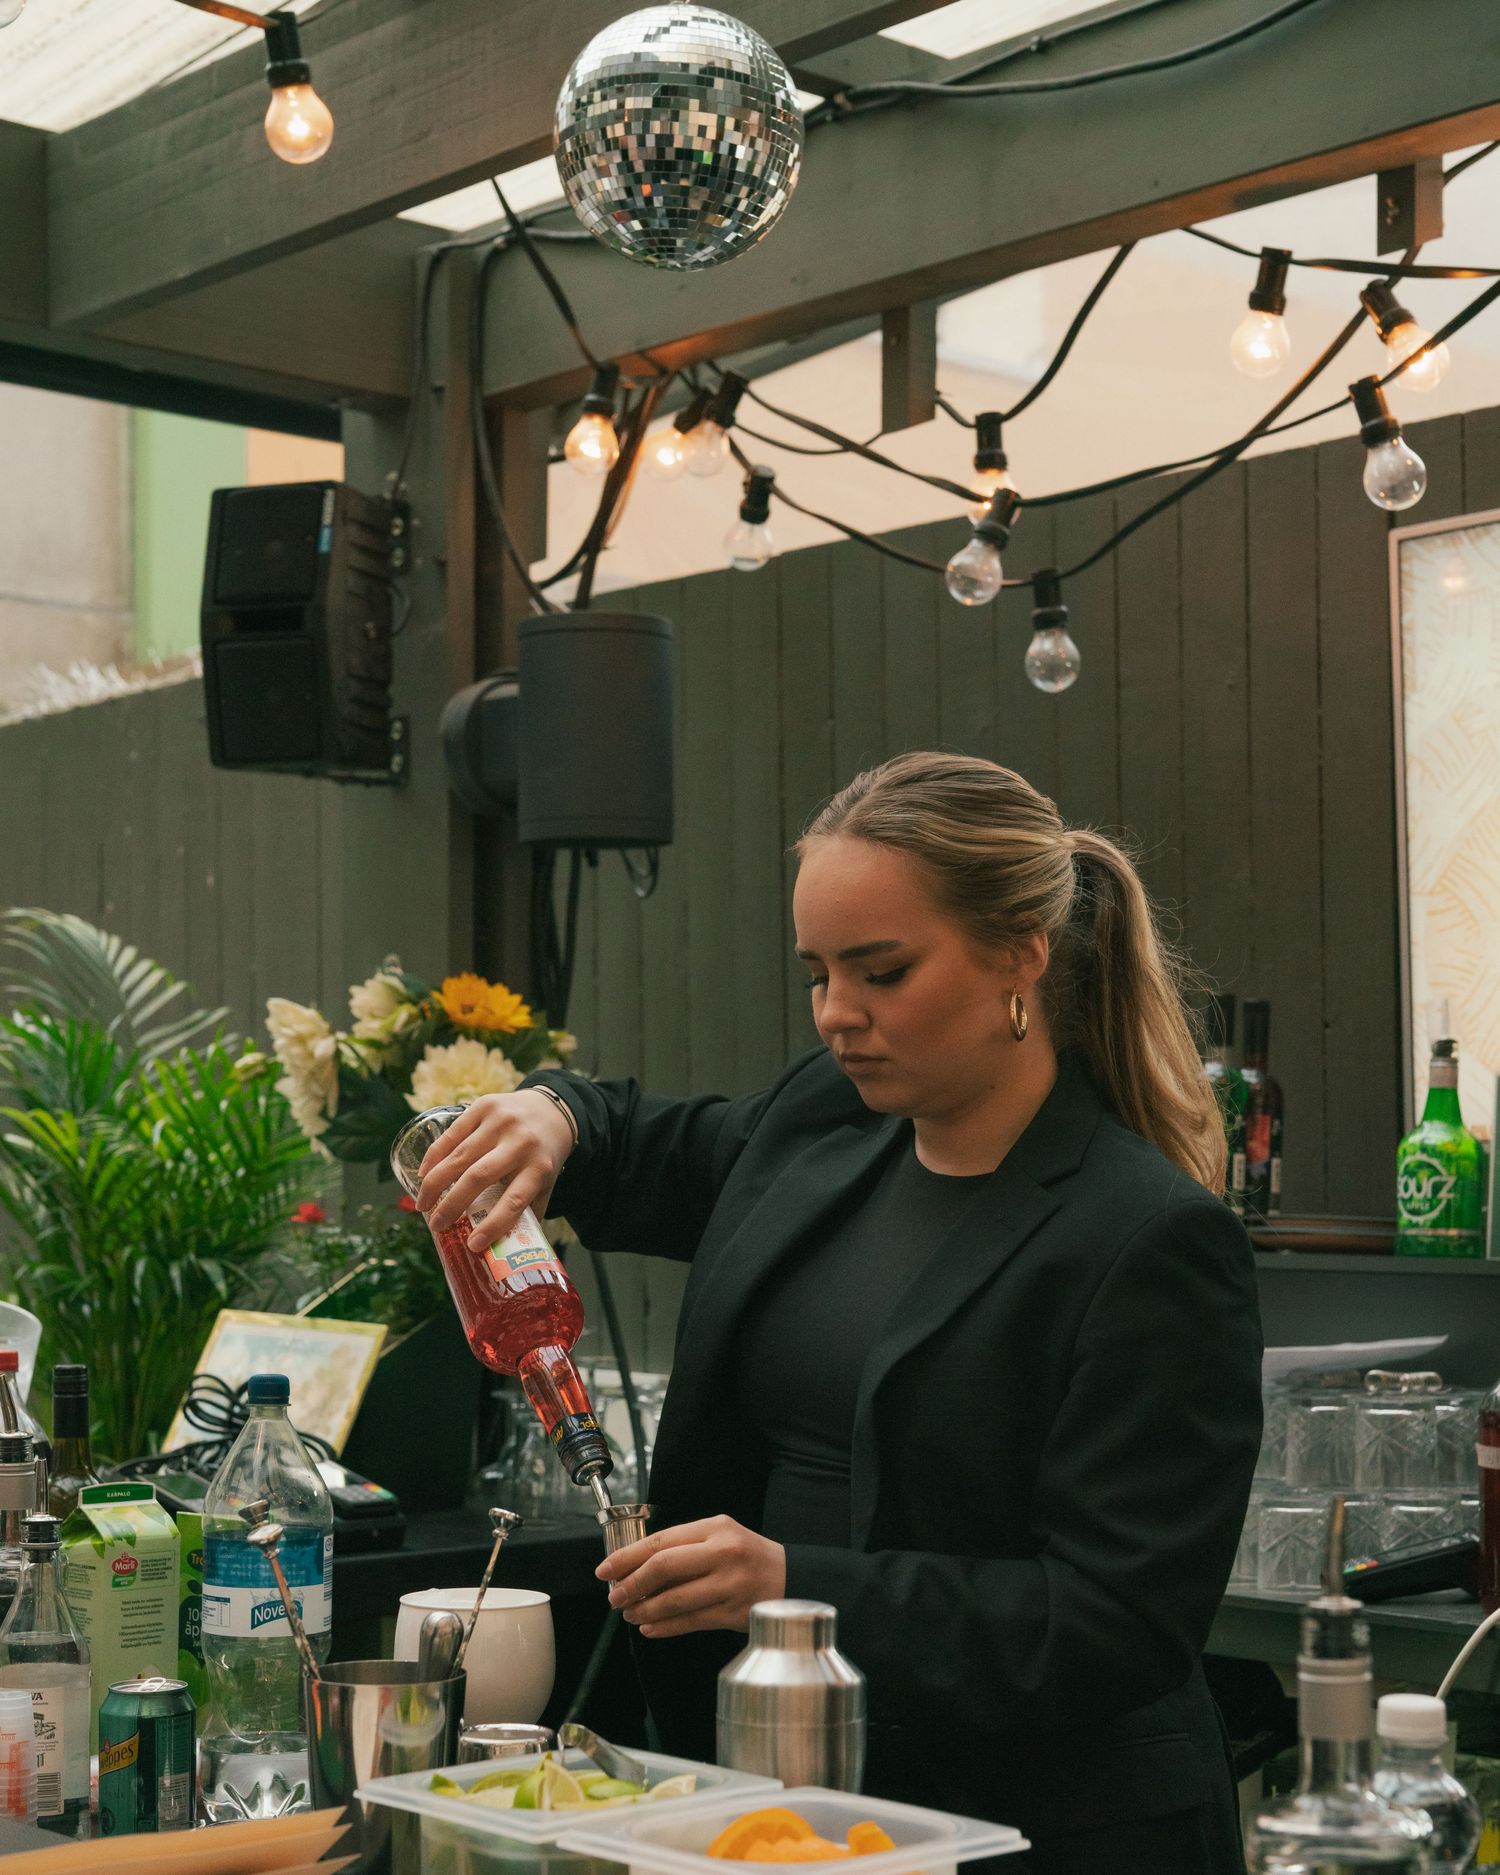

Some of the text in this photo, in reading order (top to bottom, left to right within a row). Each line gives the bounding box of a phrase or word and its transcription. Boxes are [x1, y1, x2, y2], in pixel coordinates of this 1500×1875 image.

[106, 1490, 131, 1498] KARPALO
[114, 1559, 136, 1571] Marli
[188, 1607, 200, 1621] 10
[254, 1603, 300, 1625] Nove
